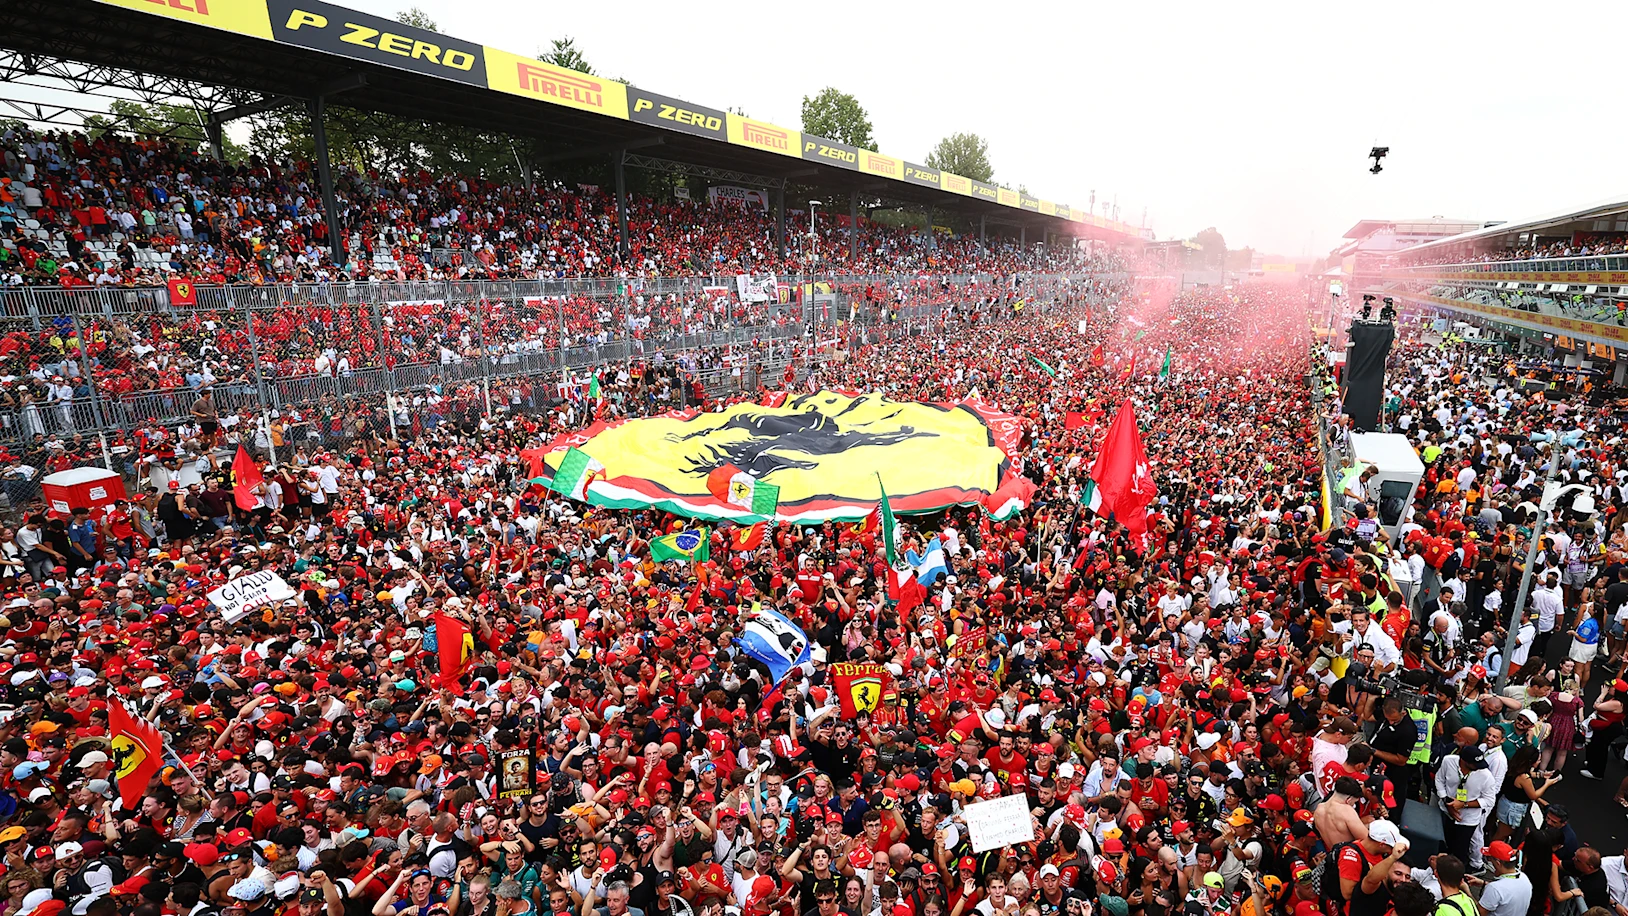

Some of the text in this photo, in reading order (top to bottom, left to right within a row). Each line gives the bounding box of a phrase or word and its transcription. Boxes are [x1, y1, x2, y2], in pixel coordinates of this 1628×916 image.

[285, 9, 475, 71] P ZERO
[517, 62, 603, 107] PIRELLI
[633, 98, 722, 131] P ZERO
[743, 122, 788, 150] PIRELLI
[805, 141, 856, 163] P ZERO
[867, 154, 896, 175] PIRELLI
[905, 168, 939, 183] P ZERO
[946, 176, 966, 192] PIRELLI
[716, 187, 745, 198] CHARLES
[978, 187, 997, 198] ZERO
[242, 587, 267, 602] SIAMO
[224, 600, 240, 612] NOI
[501, 749, 531, 759] FORZA
[500, 789, 532, 799] FERARI
